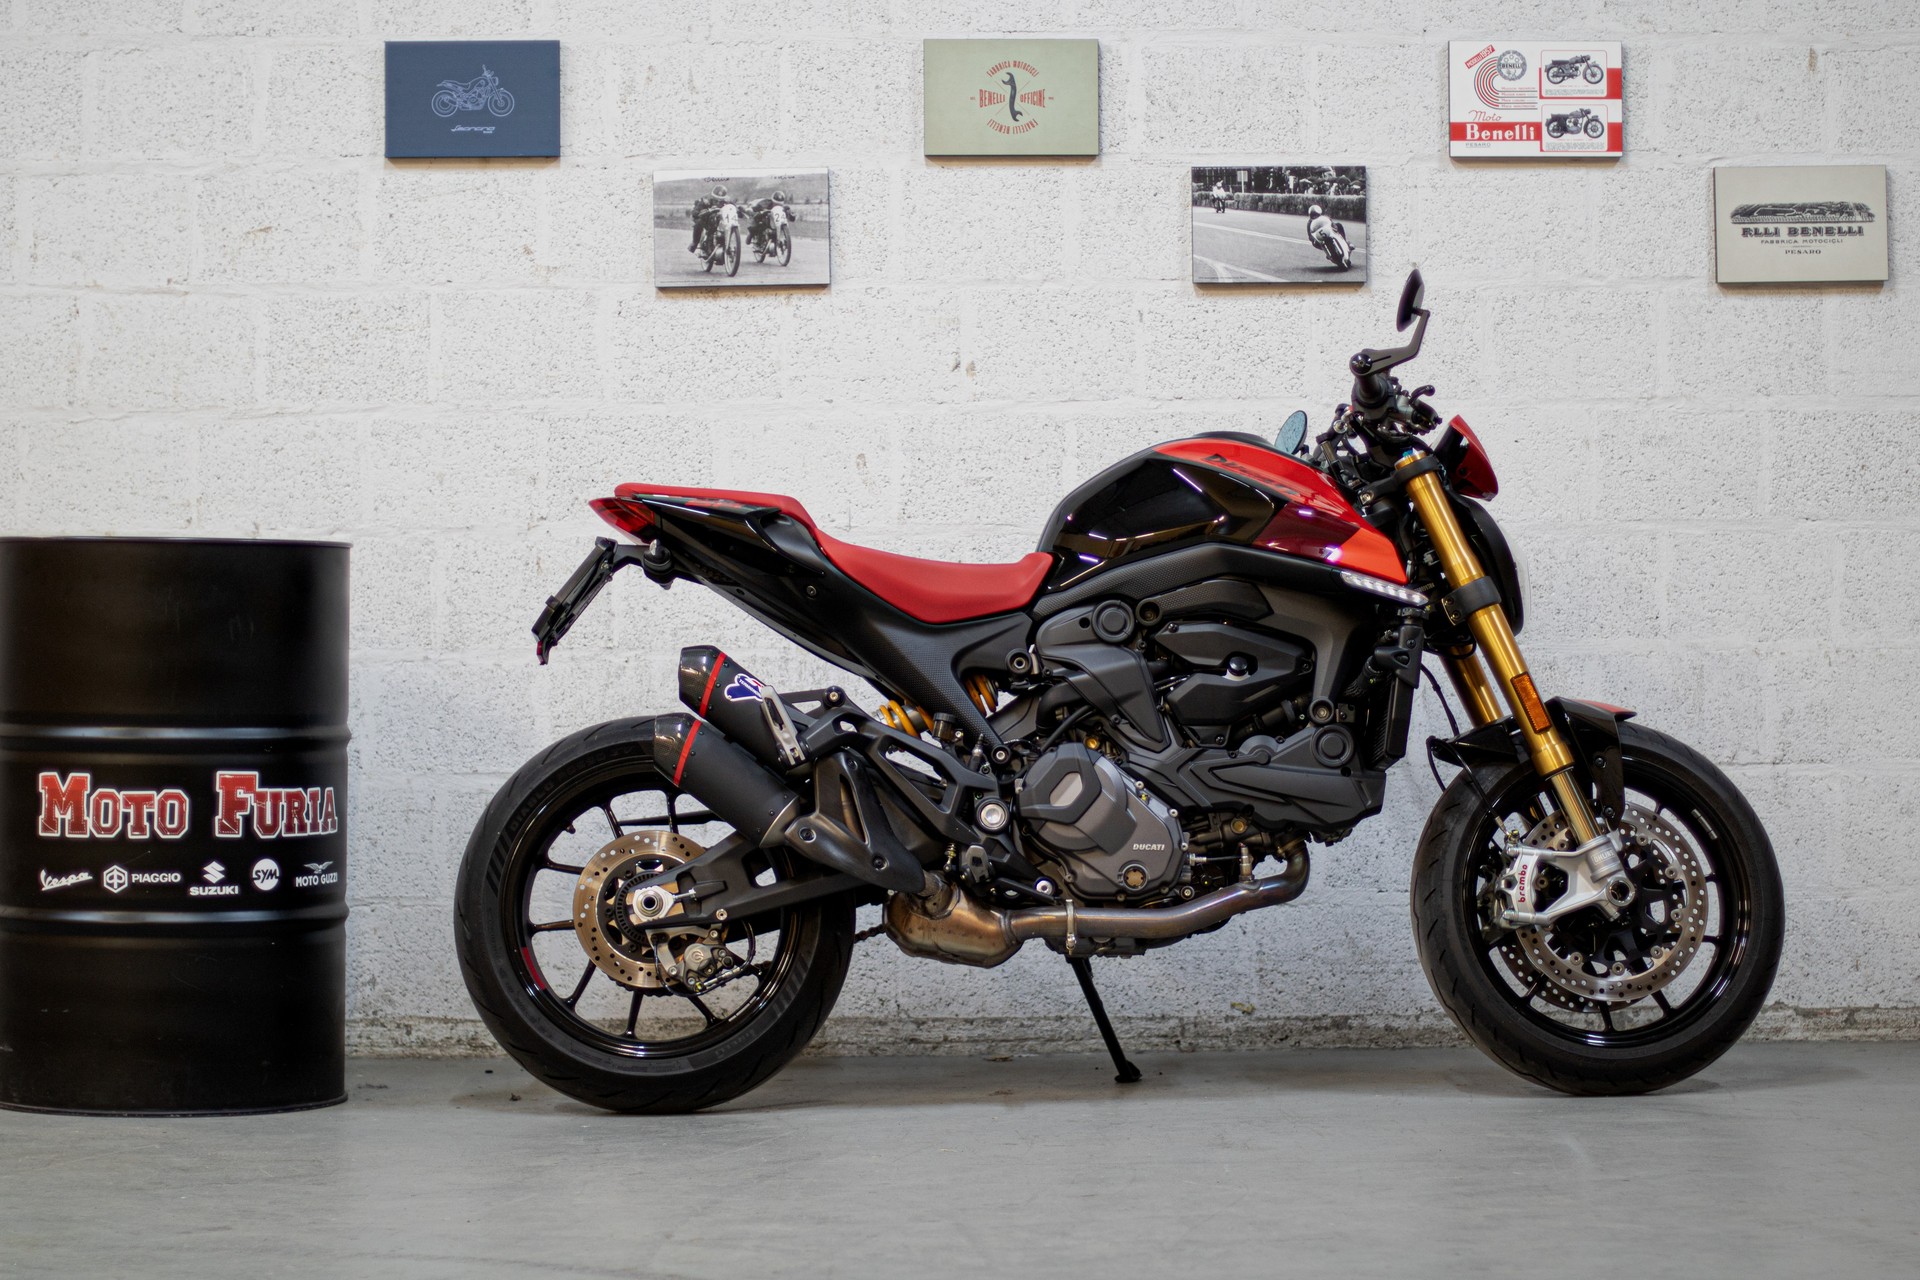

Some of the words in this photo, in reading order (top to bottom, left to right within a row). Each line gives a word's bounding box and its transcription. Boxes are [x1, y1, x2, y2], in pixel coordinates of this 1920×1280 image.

[1481, 45, 1493, 58] 1957
[979, 89, 1006, 108] BENELLI
[1019, 89, 1046, 108] OFFICINE
[1468, 109, 1502, 122] Moto
[1465, 123, 1535, 140] Benelli
[1787, 225, 1865, 237] BENELLI
[1132, 843, 1165, 851] DUCATI
[39, 868, 93, 891] Vespa
[131, 871, 182, 884] PIAGGIO
[252, 868, 280, 887] SYM
[295, 875, 319, 888] MOTO
[320, 871, 339, 884] GUZZI
[1517, 864, 1528, 903] brembo
[189, 884, 239, 896] SUZUKI
